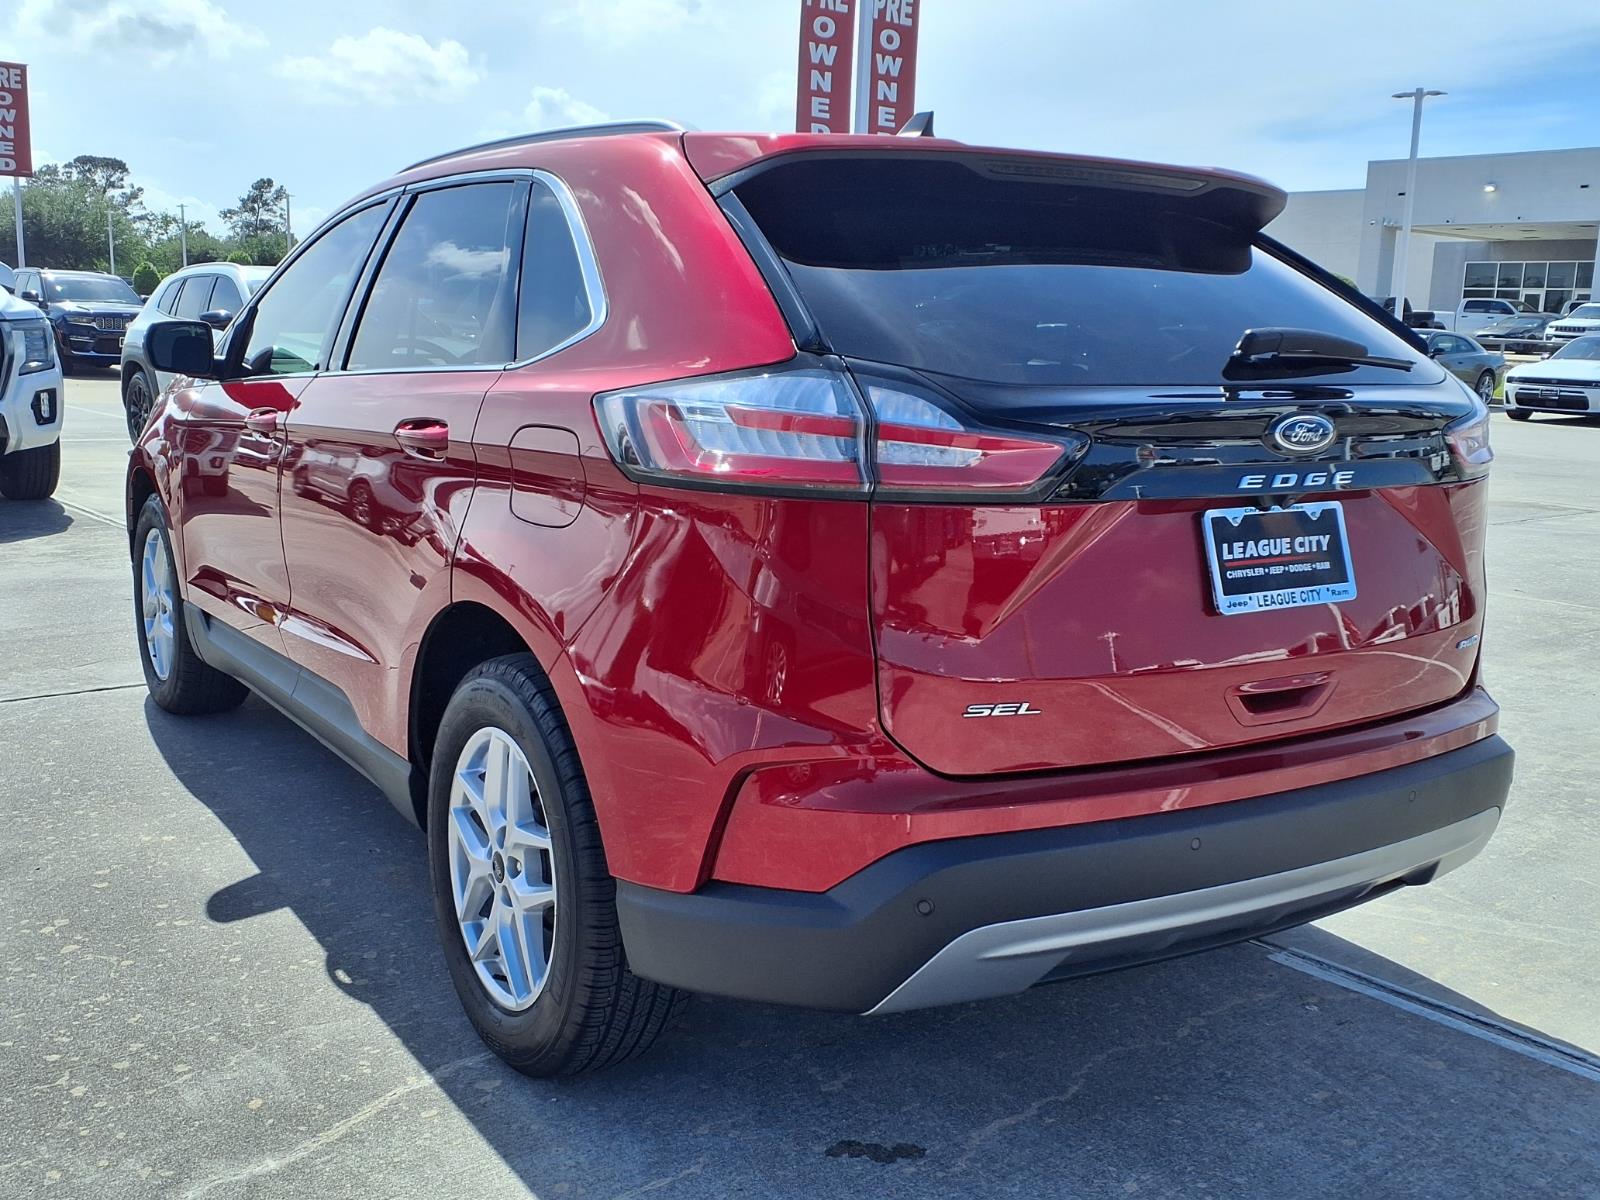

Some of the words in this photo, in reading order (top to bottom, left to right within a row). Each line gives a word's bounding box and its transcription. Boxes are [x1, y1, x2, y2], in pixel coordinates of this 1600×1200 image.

[873, 0, 913, 26] PRE
[0, 66, 22, 89] RE
[875, 28, 903, 135] OWNE
[1291, 422, 1324, 442] Ford
[1238, 470, 1355, 489] EDGE
[1222, 537, 1292, 560] LEAGUE
[1294, 534, 1331, 553] CITY
[1226, 567, 1265, 579] CHRYSLER
[1269, 565, 1285, 575] JEEP
[1289, 563, 1312, 573] DODGE
[1316, 561, 1331, 570] RAM
[1226, 601, 1249, 609] Jeep
[1256, 591, 1298, 608] LEAGUE
[1300, 588, 1322, 603] CITY
[1331, 588, 1350, 597] Ram
[962, 702, 1042, 718] SEL
